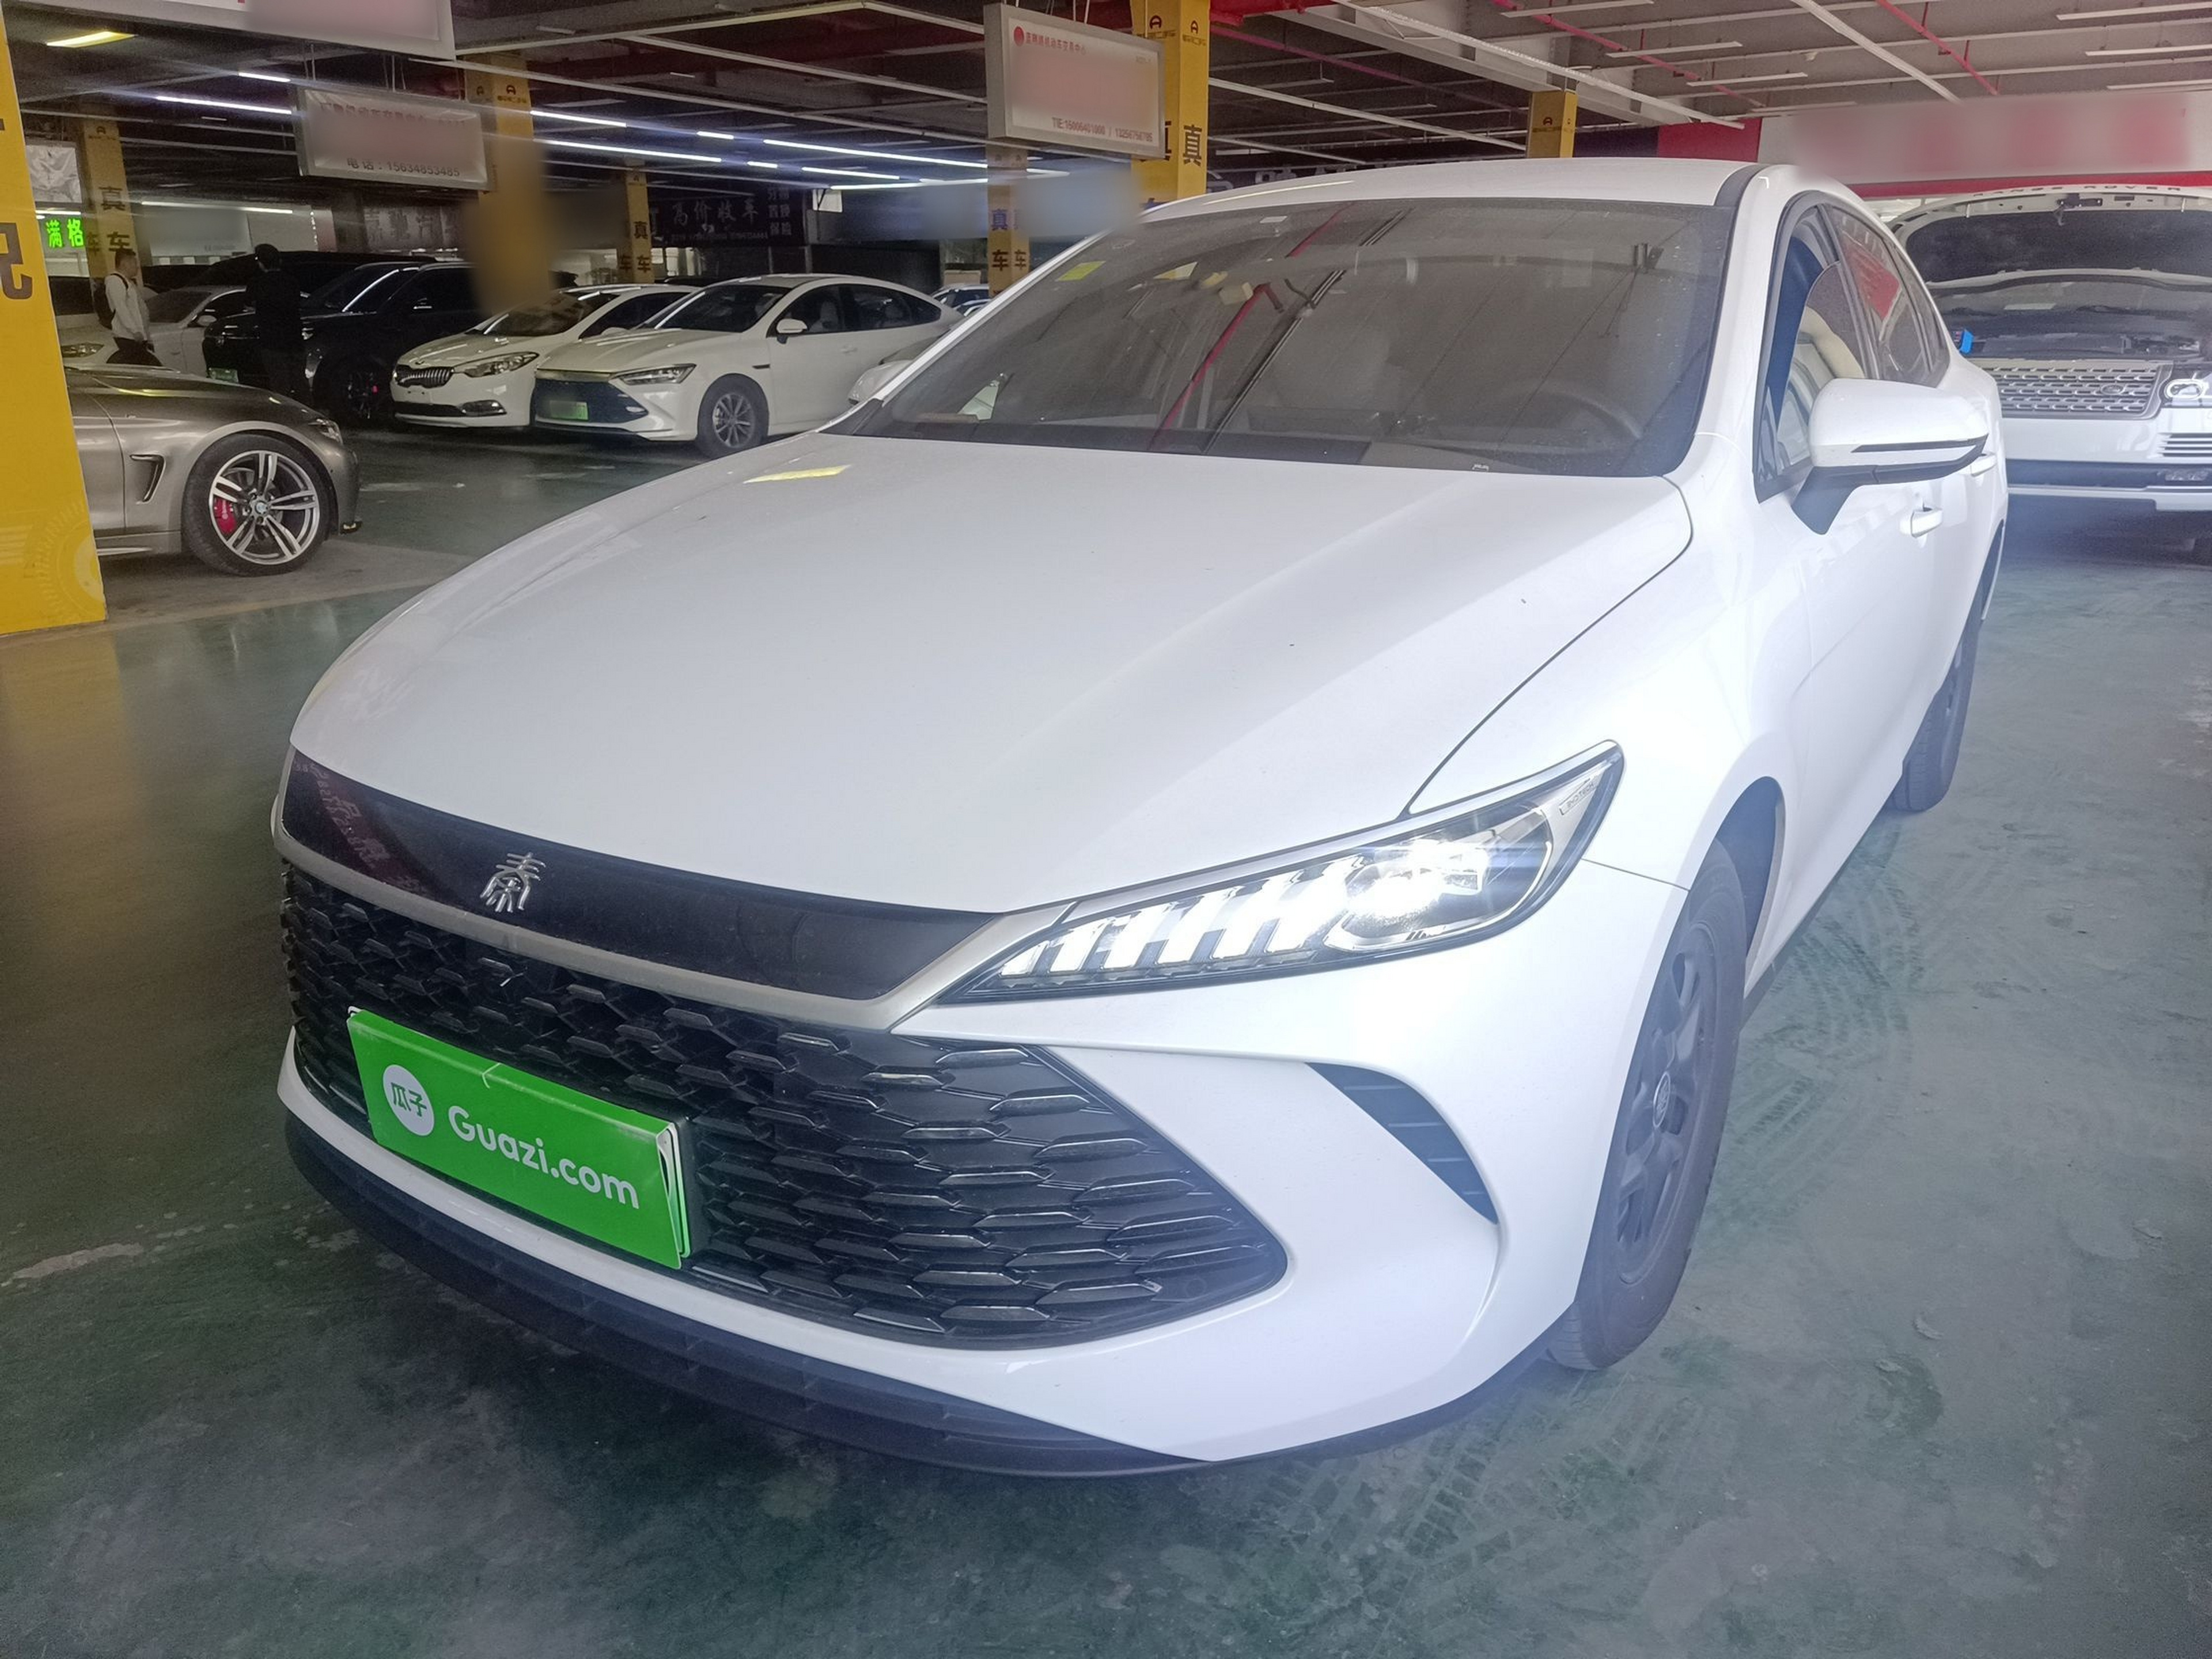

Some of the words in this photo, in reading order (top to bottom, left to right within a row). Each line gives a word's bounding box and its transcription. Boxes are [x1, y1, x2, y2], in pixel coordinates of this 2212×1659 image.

[1183, 124, 1202, 166] 真
[391, 1082, 427, 1118] 瓜子
[448, 1105, 640, 1210] Guazi.com
